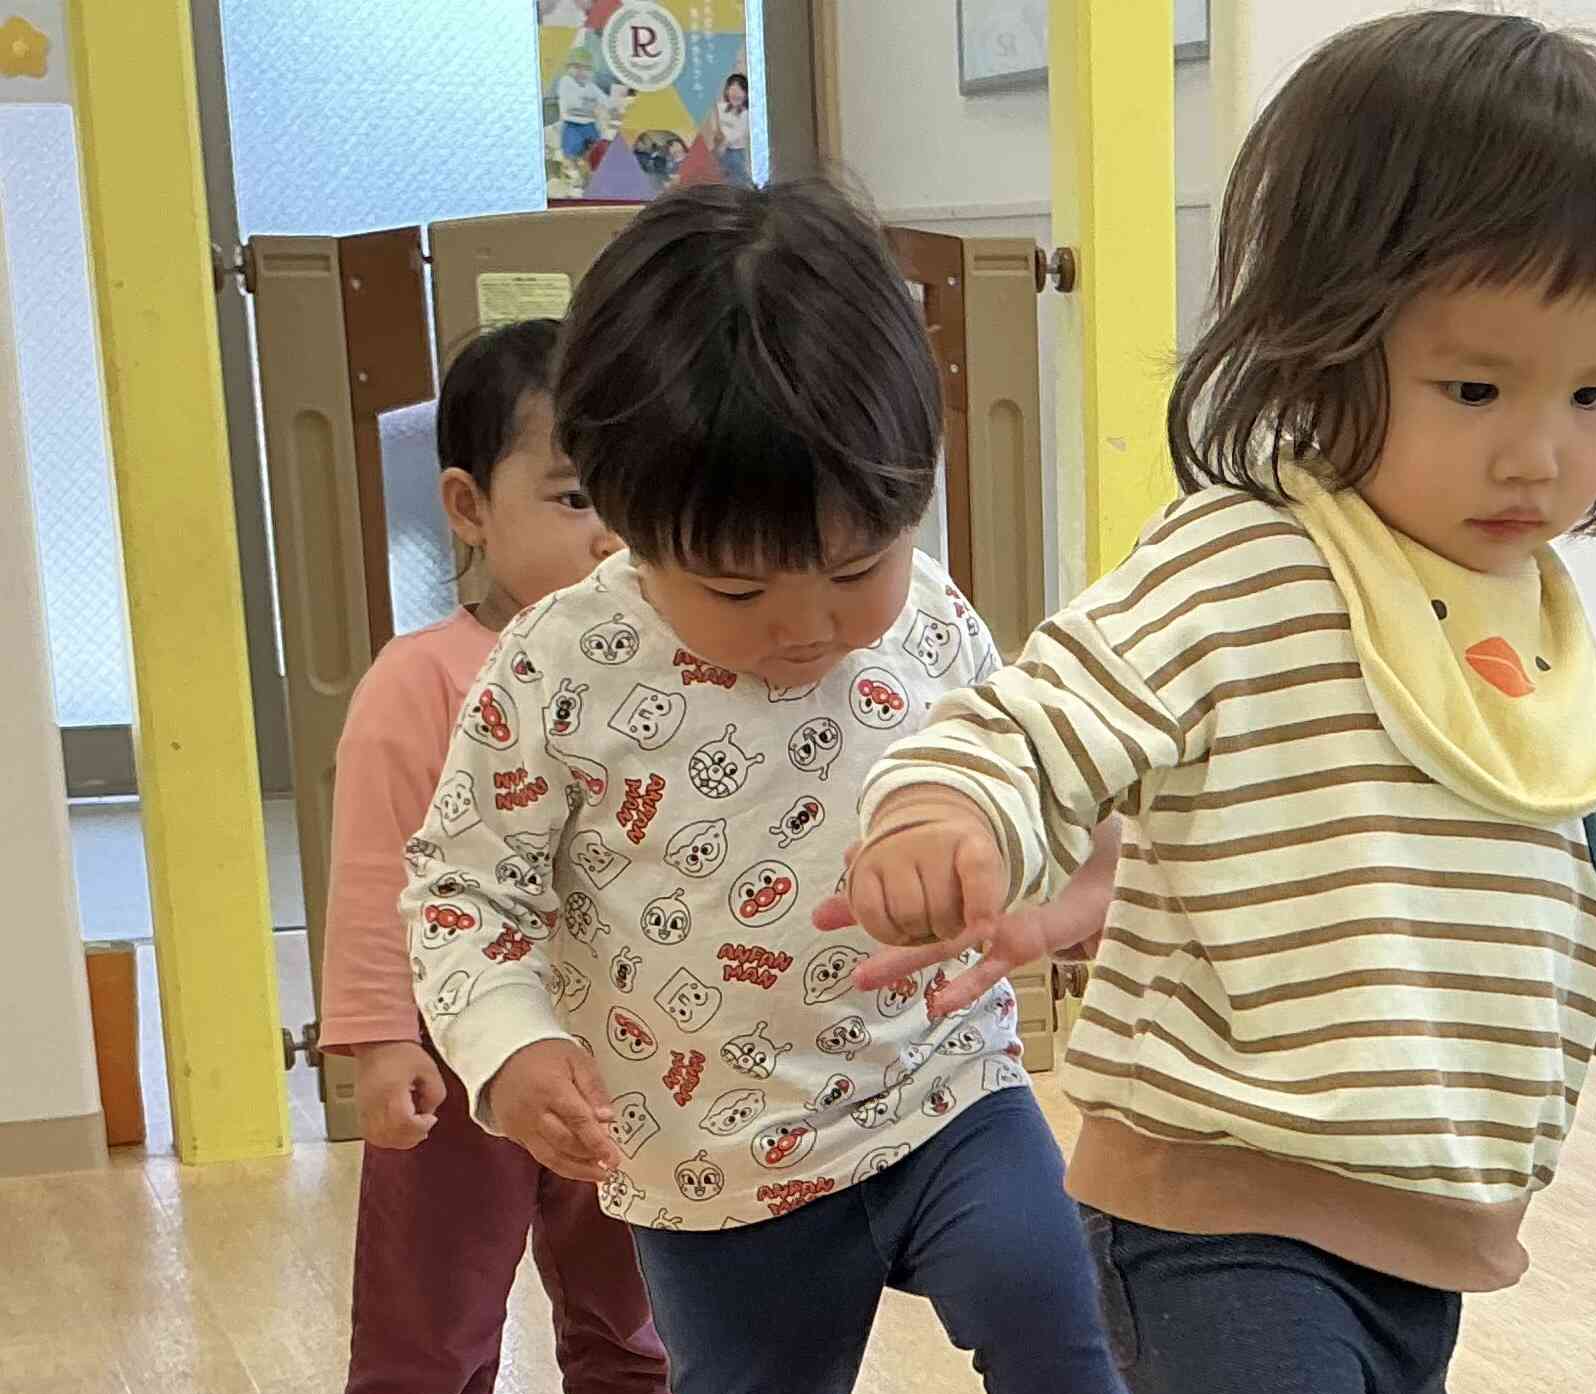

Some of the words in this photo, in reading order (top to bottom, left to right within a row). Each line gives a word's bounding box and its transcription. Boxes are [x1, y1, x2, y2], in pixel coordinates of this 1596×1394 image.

[630, 26, 662, 58] R
[616, 778, 642, 827] MAN
[627, 773, 666, 845] ANPAN
[717, 943, 793, 973] ANPAN
[723, 965, 777, 990] MAN
[757, 1177, 835, 1201] ANPAN
